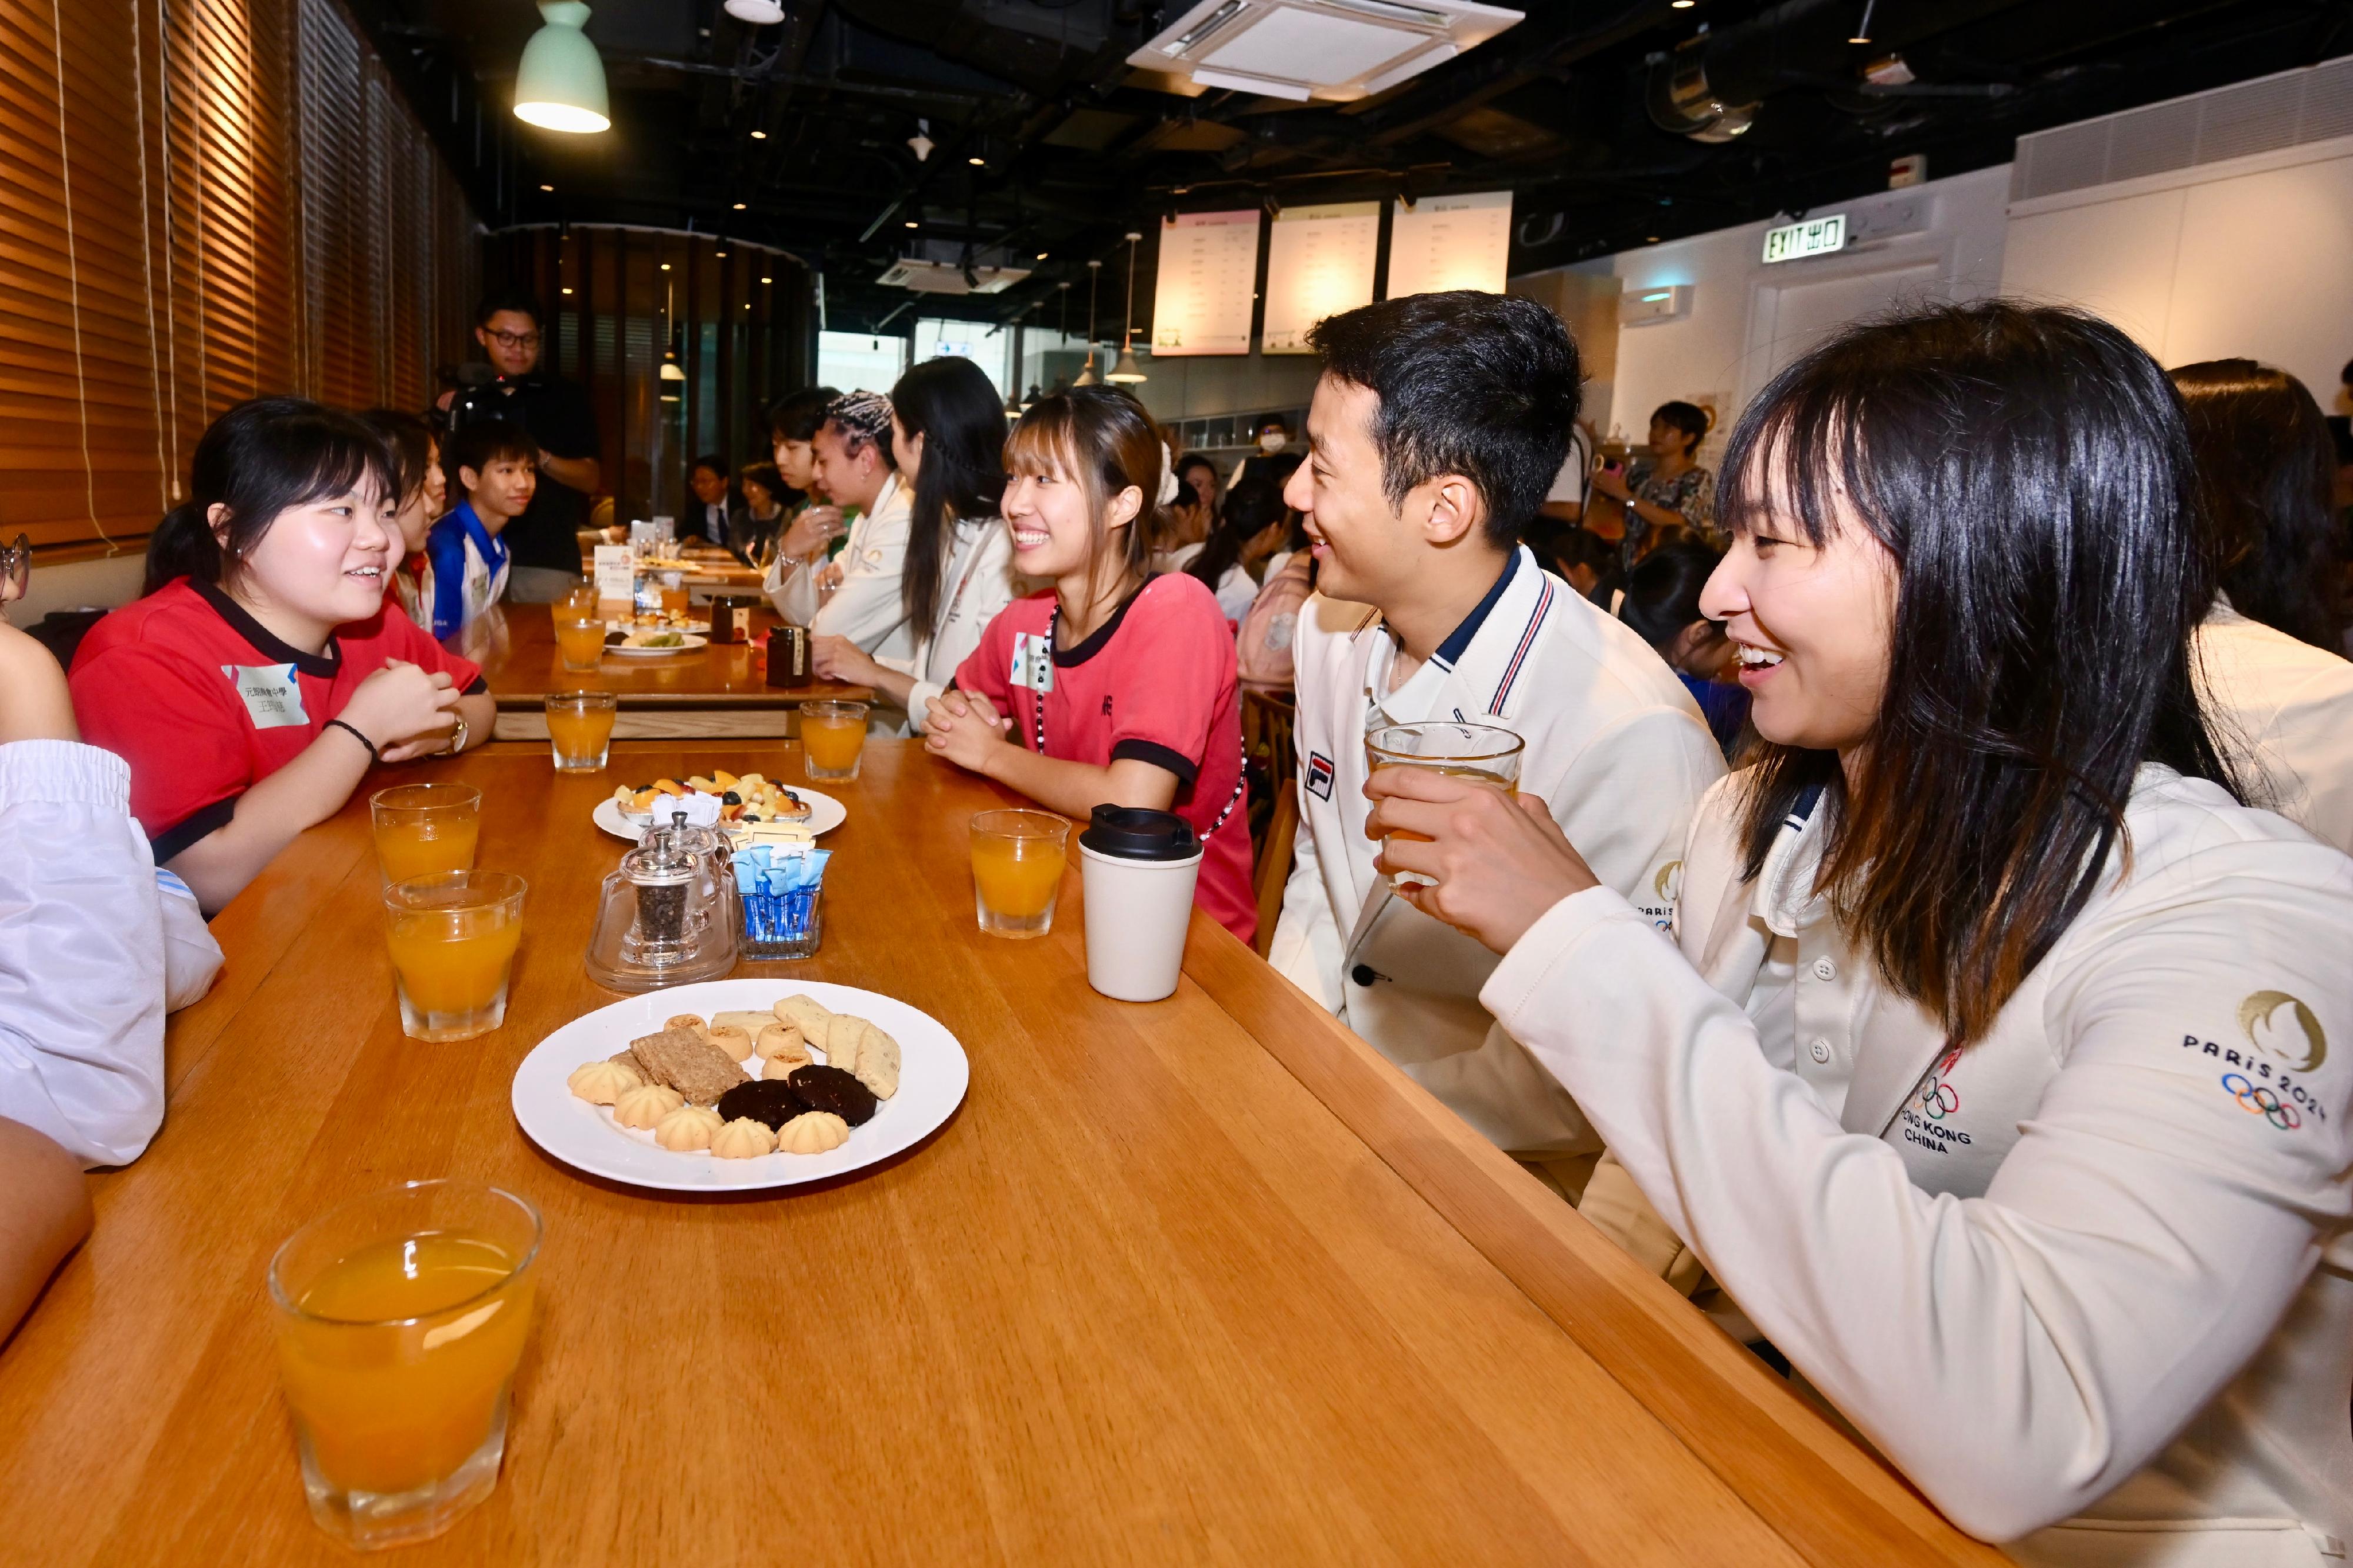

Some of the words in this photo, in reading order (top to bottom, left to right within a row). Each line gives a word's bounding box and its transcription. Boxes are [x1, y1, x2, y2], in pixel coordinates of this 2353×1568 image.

[1769, 227, 1803, 259] EXIT
[1807, 219, 1839, 251] 出口
[1904, 1127, 1949, 1155] CHINA
[1923, 1120, 1972, 1145] KONG
